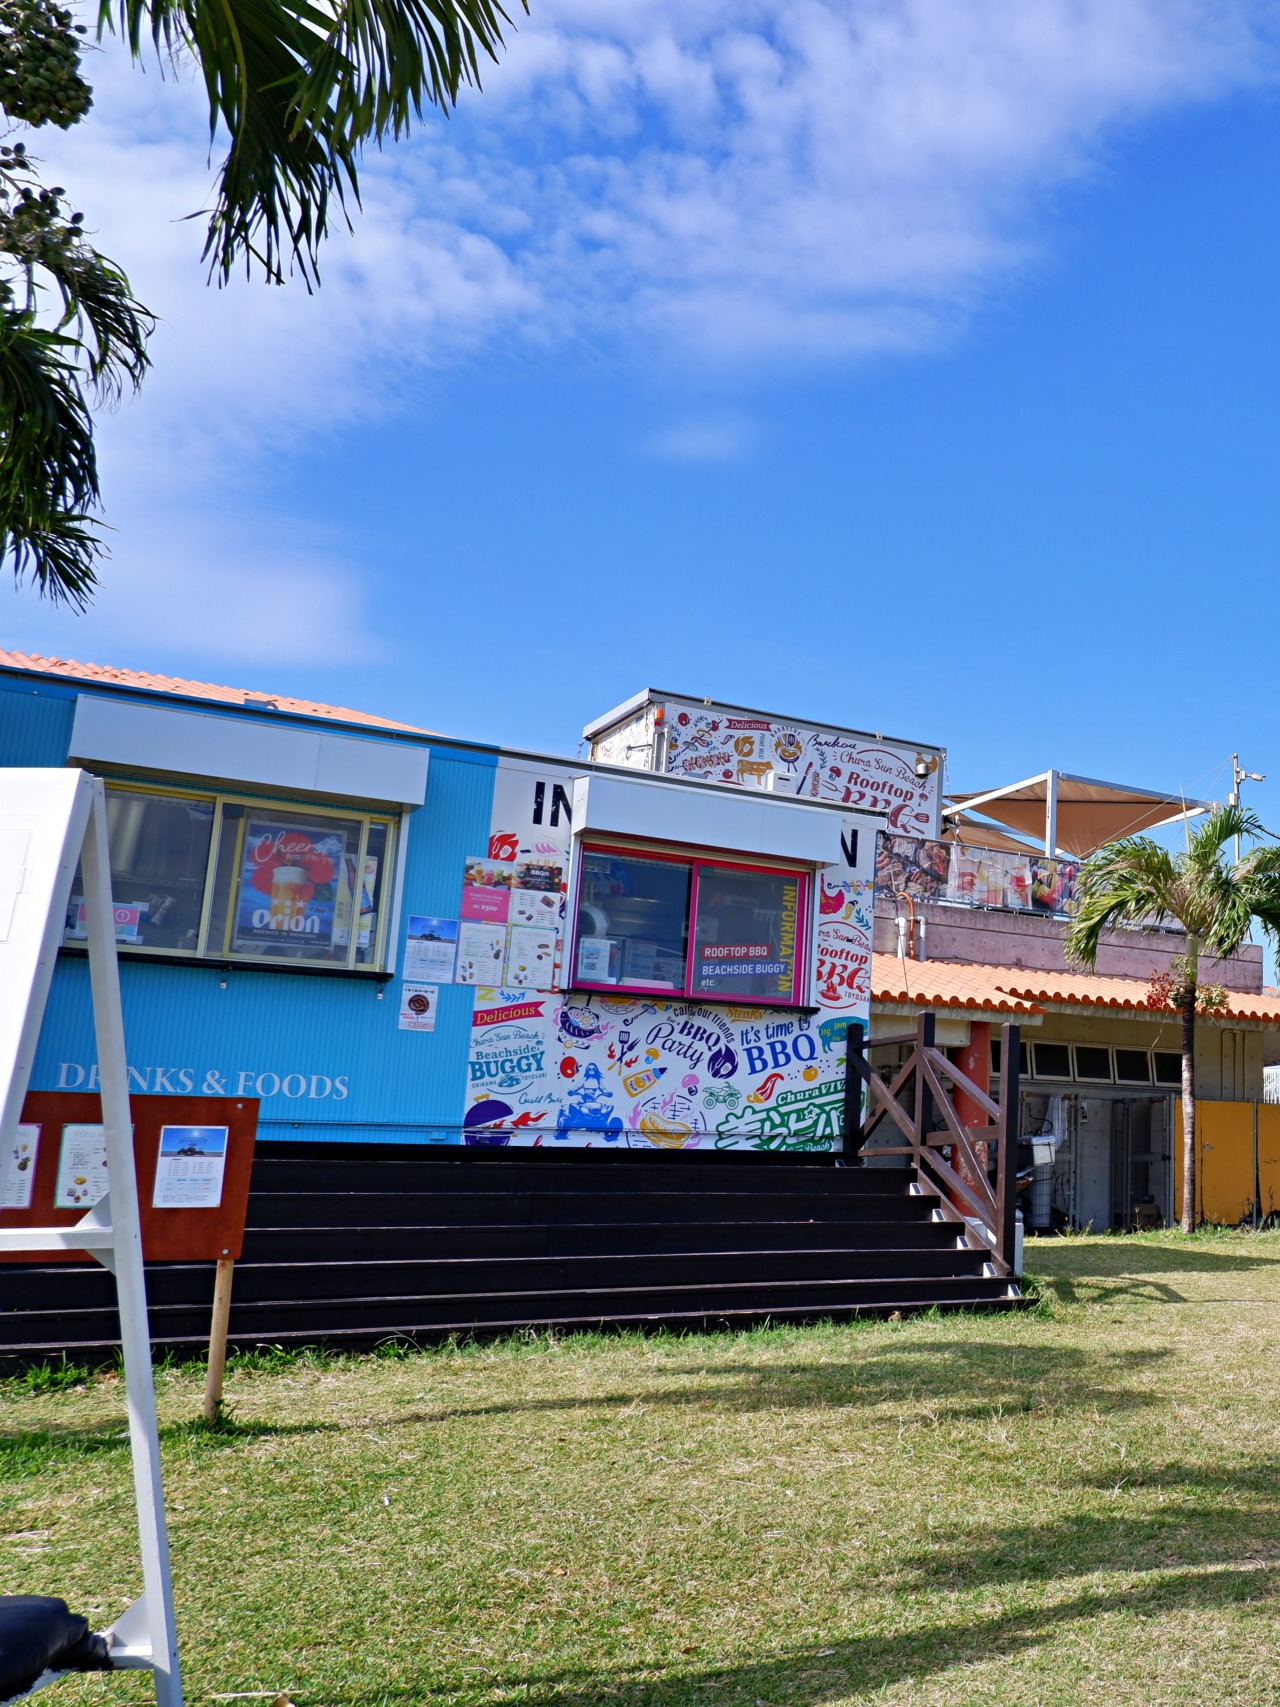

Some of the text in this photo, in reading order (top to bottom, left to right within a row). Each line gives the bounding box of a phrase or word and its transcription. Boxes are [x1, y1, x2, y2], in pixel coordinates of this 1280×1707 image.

[731, 720, 767, 730] Delicious
[840, 751, 927, 791] Chura Sun Beach
[847, 772, 914, 802] Rooftop
[704, 946, 768, 957] ROOFTOP BBQ
[817, 944, 868, 966] ooftop
[702, 963, 786, 975] BEACHSIDE BUGGY
[701, 978, 716, 986] etc.
[476, 1006, 536, 1024] Delicious
[495, 1032, 511, 1042] Sun
[513, 1030, 539, 1040] Beach
[678, 1020, 721, 1052] BBQ
[711, 1013, 735, 1043] friends
[741, 1026, 761, 1047] It's
[766, 1021, 794, 1040] time
[476, 1044, 536, 1061] Beachside
[646, 1022, 704, 1070] Party
[742, 1033, 818, 1075] BBQ
[469, 1050, 545, 1081] BUGGY
[202, 1070, 228, 1095] &
[235, 1071, 349, 1100] FOODS
[472, 1072, 547, 1088] OKINAWA TOYOSAKI
